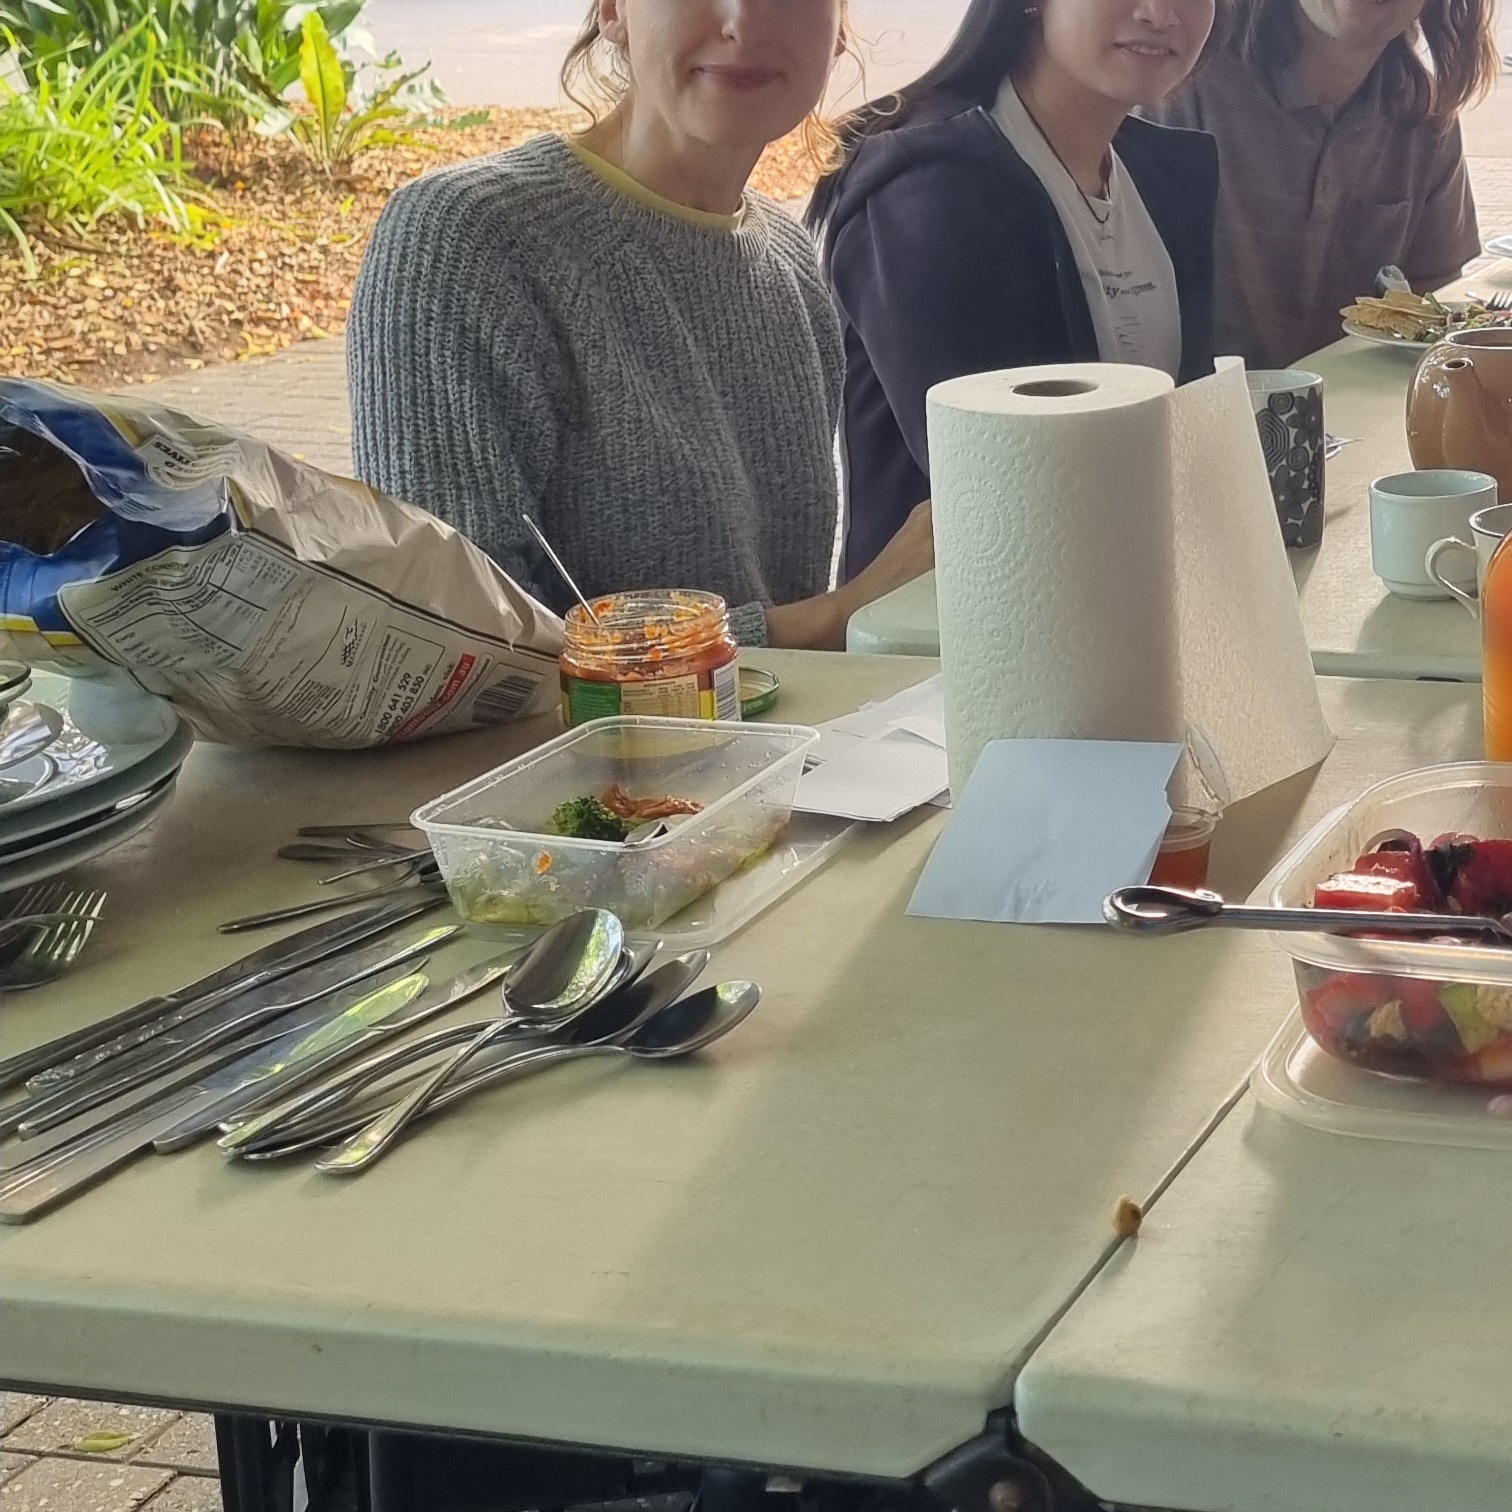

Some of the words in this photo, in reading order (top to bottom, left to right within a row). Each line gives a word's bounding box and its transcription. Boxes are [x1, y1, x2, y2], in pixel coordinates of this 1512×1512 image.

[387, 692, 402, 715] 641
[398, 672, 413, 692] 529
[401, 696, 414, 717] 403
[410, 675, 425, 696] 850
